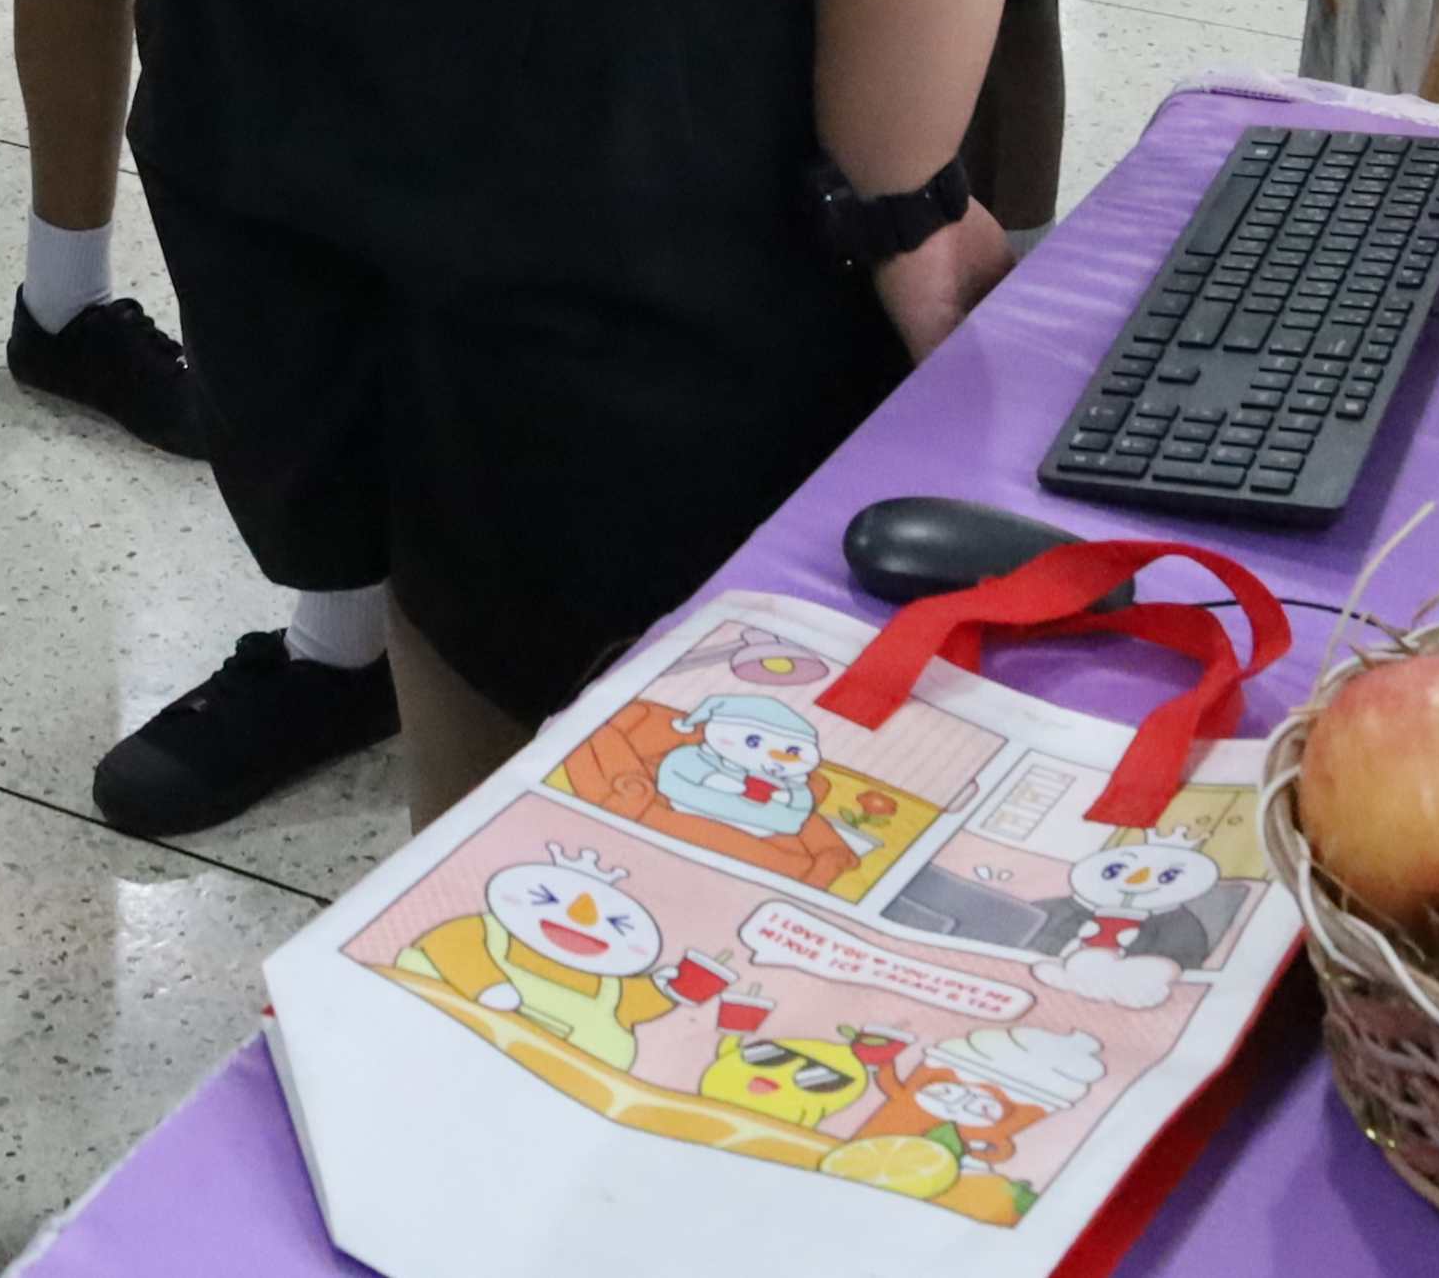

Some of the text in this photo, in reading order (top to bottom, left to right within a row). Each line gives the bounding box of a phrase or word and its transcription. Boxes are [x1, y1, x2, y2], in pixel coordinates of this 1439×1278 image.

[781, 918, 828, 946] LOVE
[831, 940, 870, 961] YOU
[934, 975, 983, 994] LOVE
